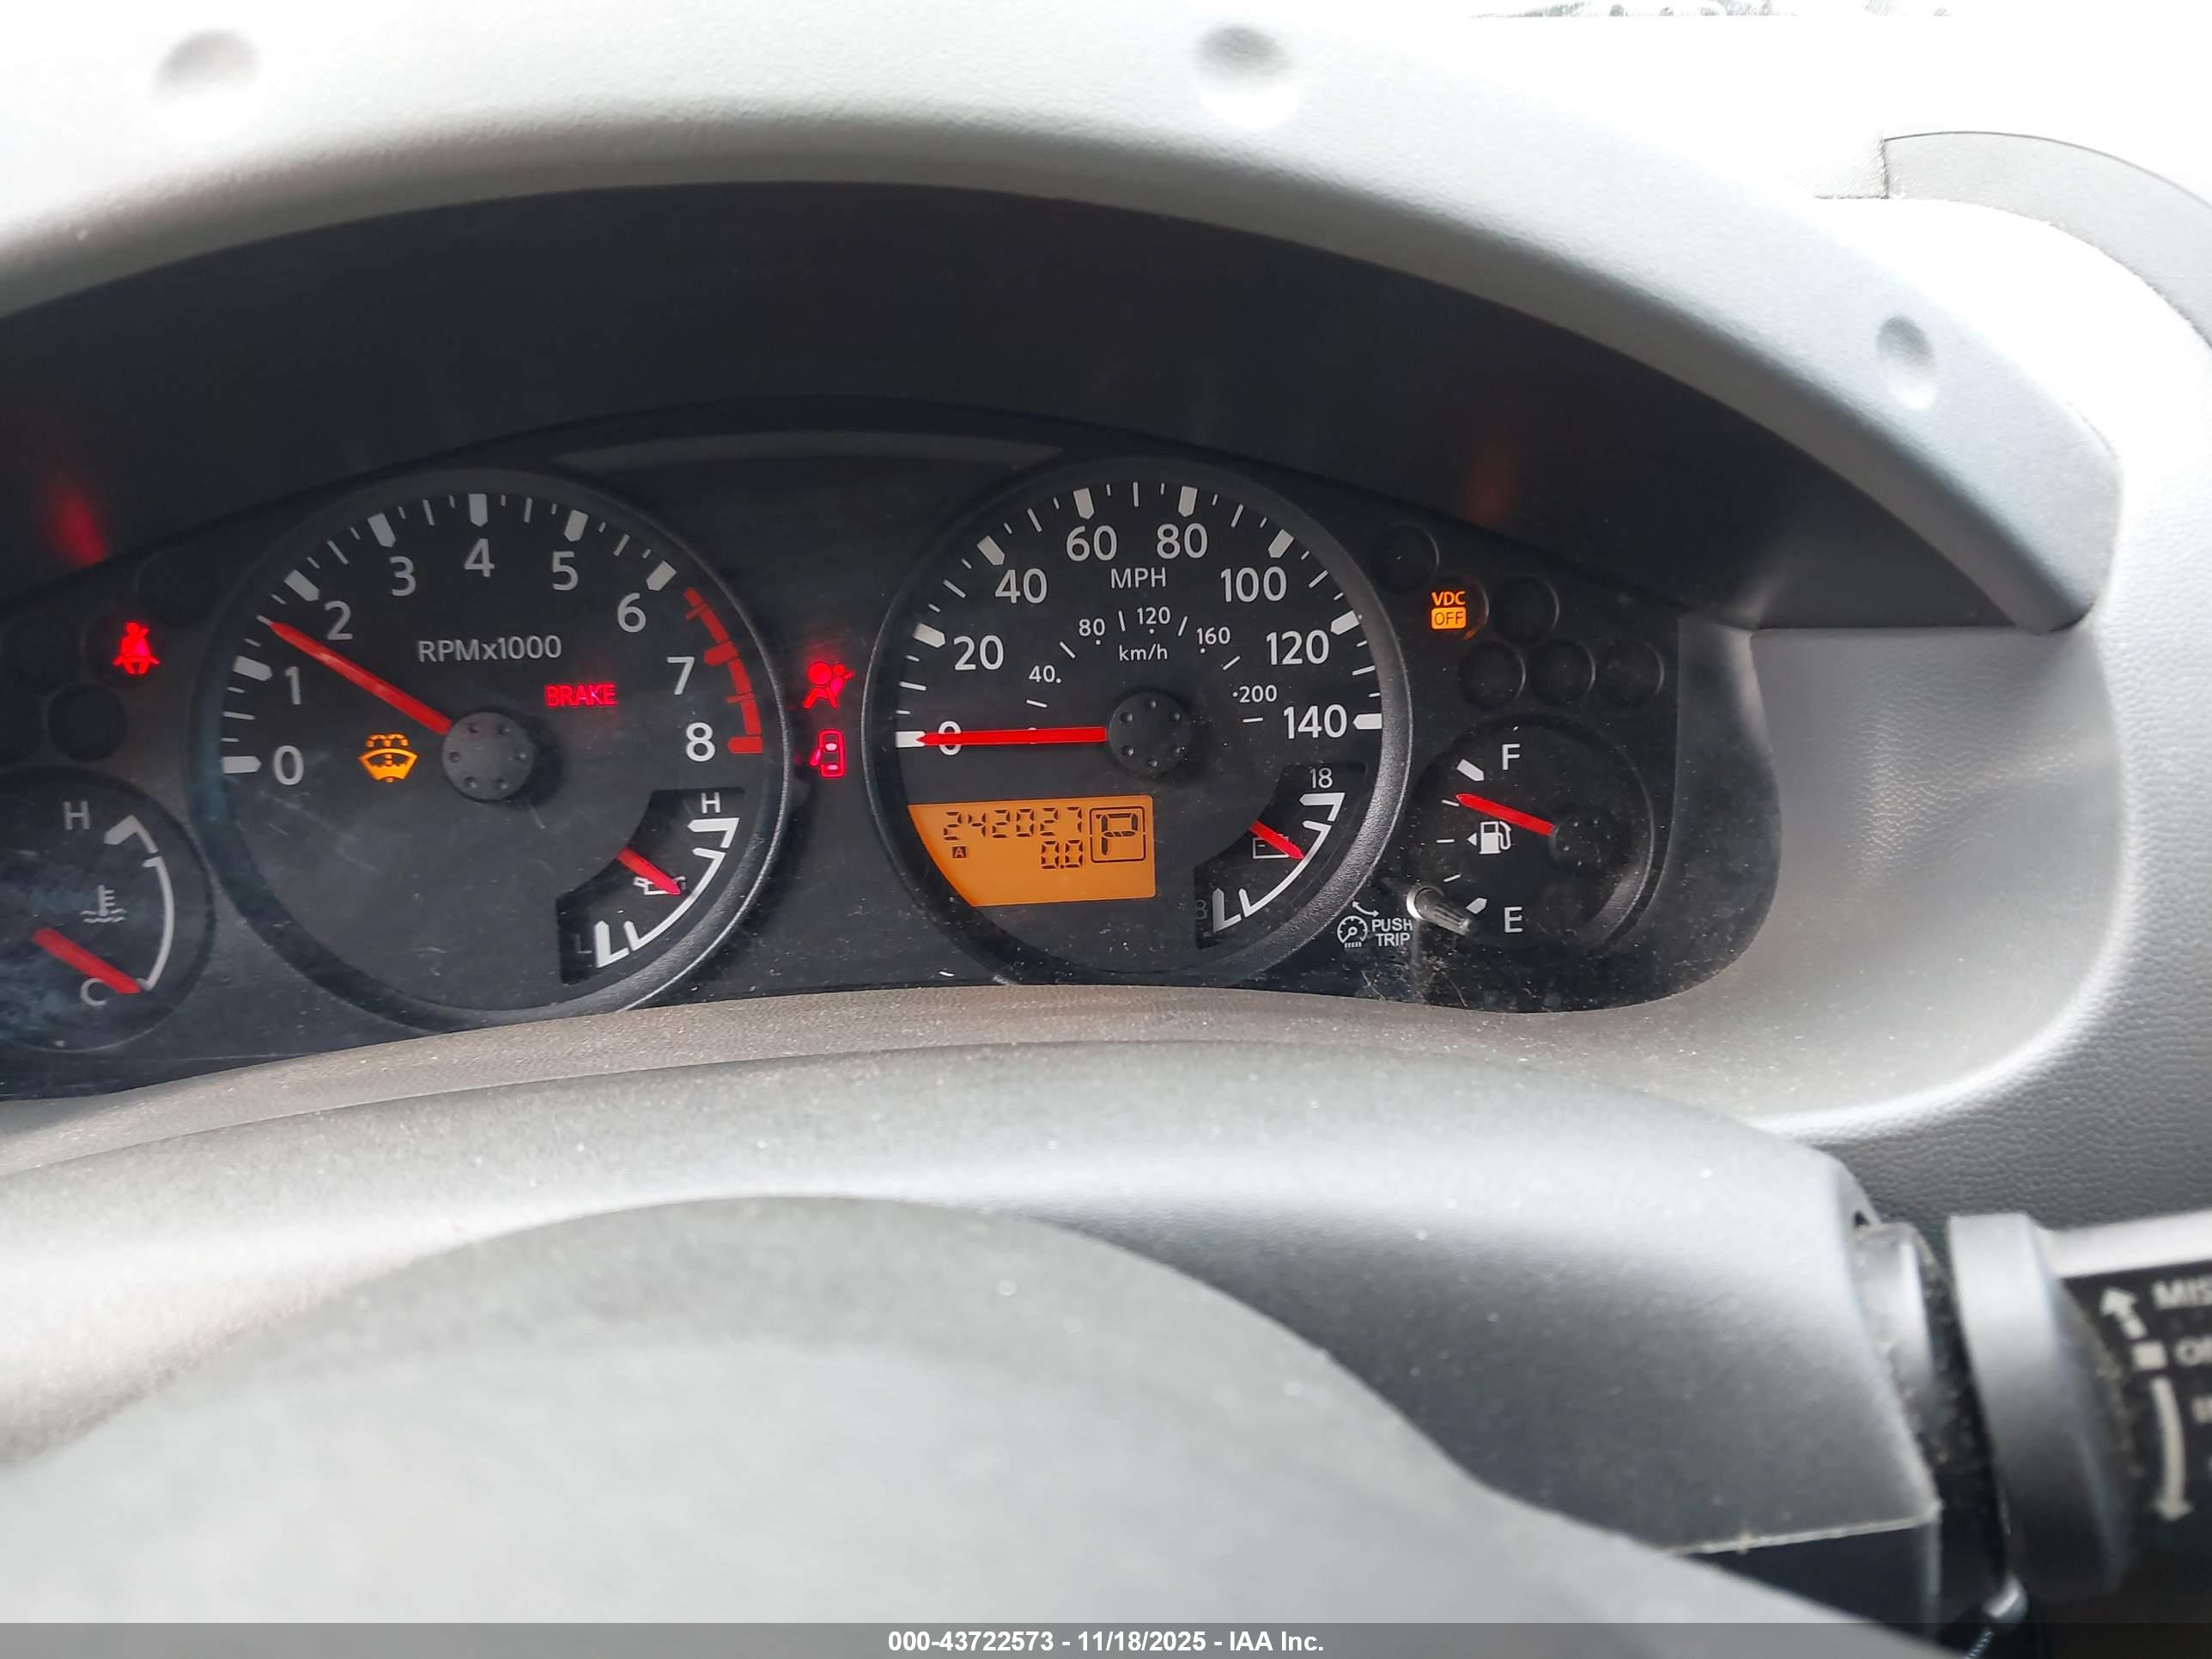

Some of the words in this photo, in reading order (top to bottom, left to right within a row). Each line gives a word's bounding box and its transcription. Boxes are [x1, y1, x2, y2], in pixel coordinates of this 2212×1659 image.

[1067, 526, 1116, 561] 60
[1158, 524, 1207, 558] 80
[465, 538, 495, 577] 4
[553, 551, 578, 590] 5
[391, 556, 416, 596] 3
[995, 568, 1047, 603] 40
[1111, 568, 1165, 588] MPH
[1221, 567, 1286, 602] 100
[618, 593, 646, 632] 6
[1431, 591, 1466, 606] VDC
[325, 601, 352, 640] 2
[1079, 618, 1104, 635] 80
[1138, 607, 1170, 624] 120
[1435, 611, 1463, 625] OFF
[419, 635, 561, 661] RPMx1000
[1197, 627, 1230, 644] 160
[1267, 629, 1330, 665] 120
[954, 635, 1003, 670] 20
[1120, 644, 1167, 660] km/h
[286, 666, 301, 704] 1
[667, 657, 694, 695] 7
[1029, 665, 1054, 682] 40
[545, 684, 617, 706] BRAKE
[1239, 685, 1277, 702] 200
[1284, 705, 1346, 738] 140
[687, 723, 714, 762] 8
[939, 721, 960, 755] 0
[274, 745, 303, 785] 0
[1503, 744, 1520, 769] F
[1311, 769, 1333, 788] 18
[64, 801, 89, 830] H
[702, 793, 720, 813] H
[944, 807, 1083, 841] 242027
[1098, 813, 1139, 856] P
[953, 847, 966, 859] A
[1040, 839, 1083, 869] 0.0
[1372, 918, 1413, 934] PUSH
[1504, 907, 1522, 933] E
[575, 933, 592, 954] L
[1376, 932, 1410, 947] TRIP
[82, 979, 106, 1006] C
